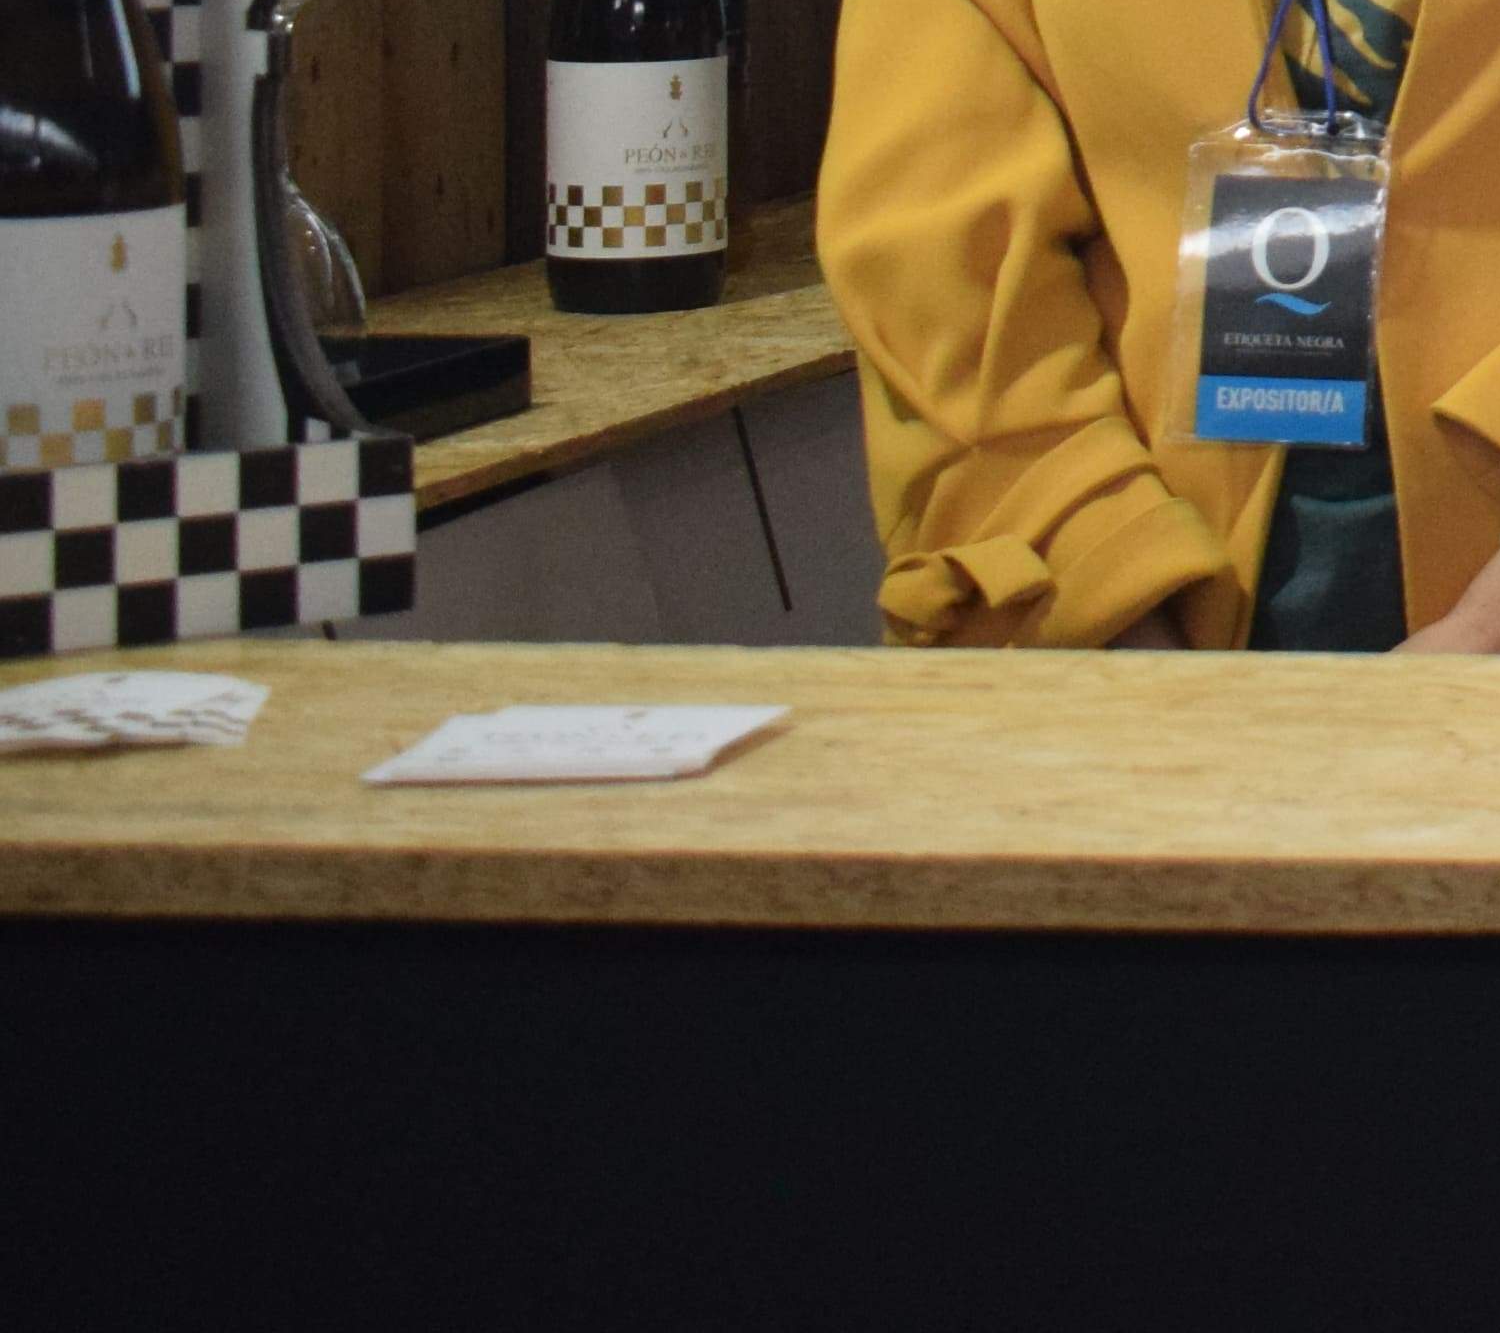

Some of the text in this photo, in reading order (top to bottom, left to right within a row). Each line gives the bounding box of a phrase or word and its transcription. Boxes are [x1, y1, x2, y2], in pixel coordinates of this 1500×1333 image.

[1251, 206, 1333, 316] Q
[1223, 331, 1346, 351] ETIQUETA NEGRA
[1215, 385, 1345, 416] EXPOSITOR/A
